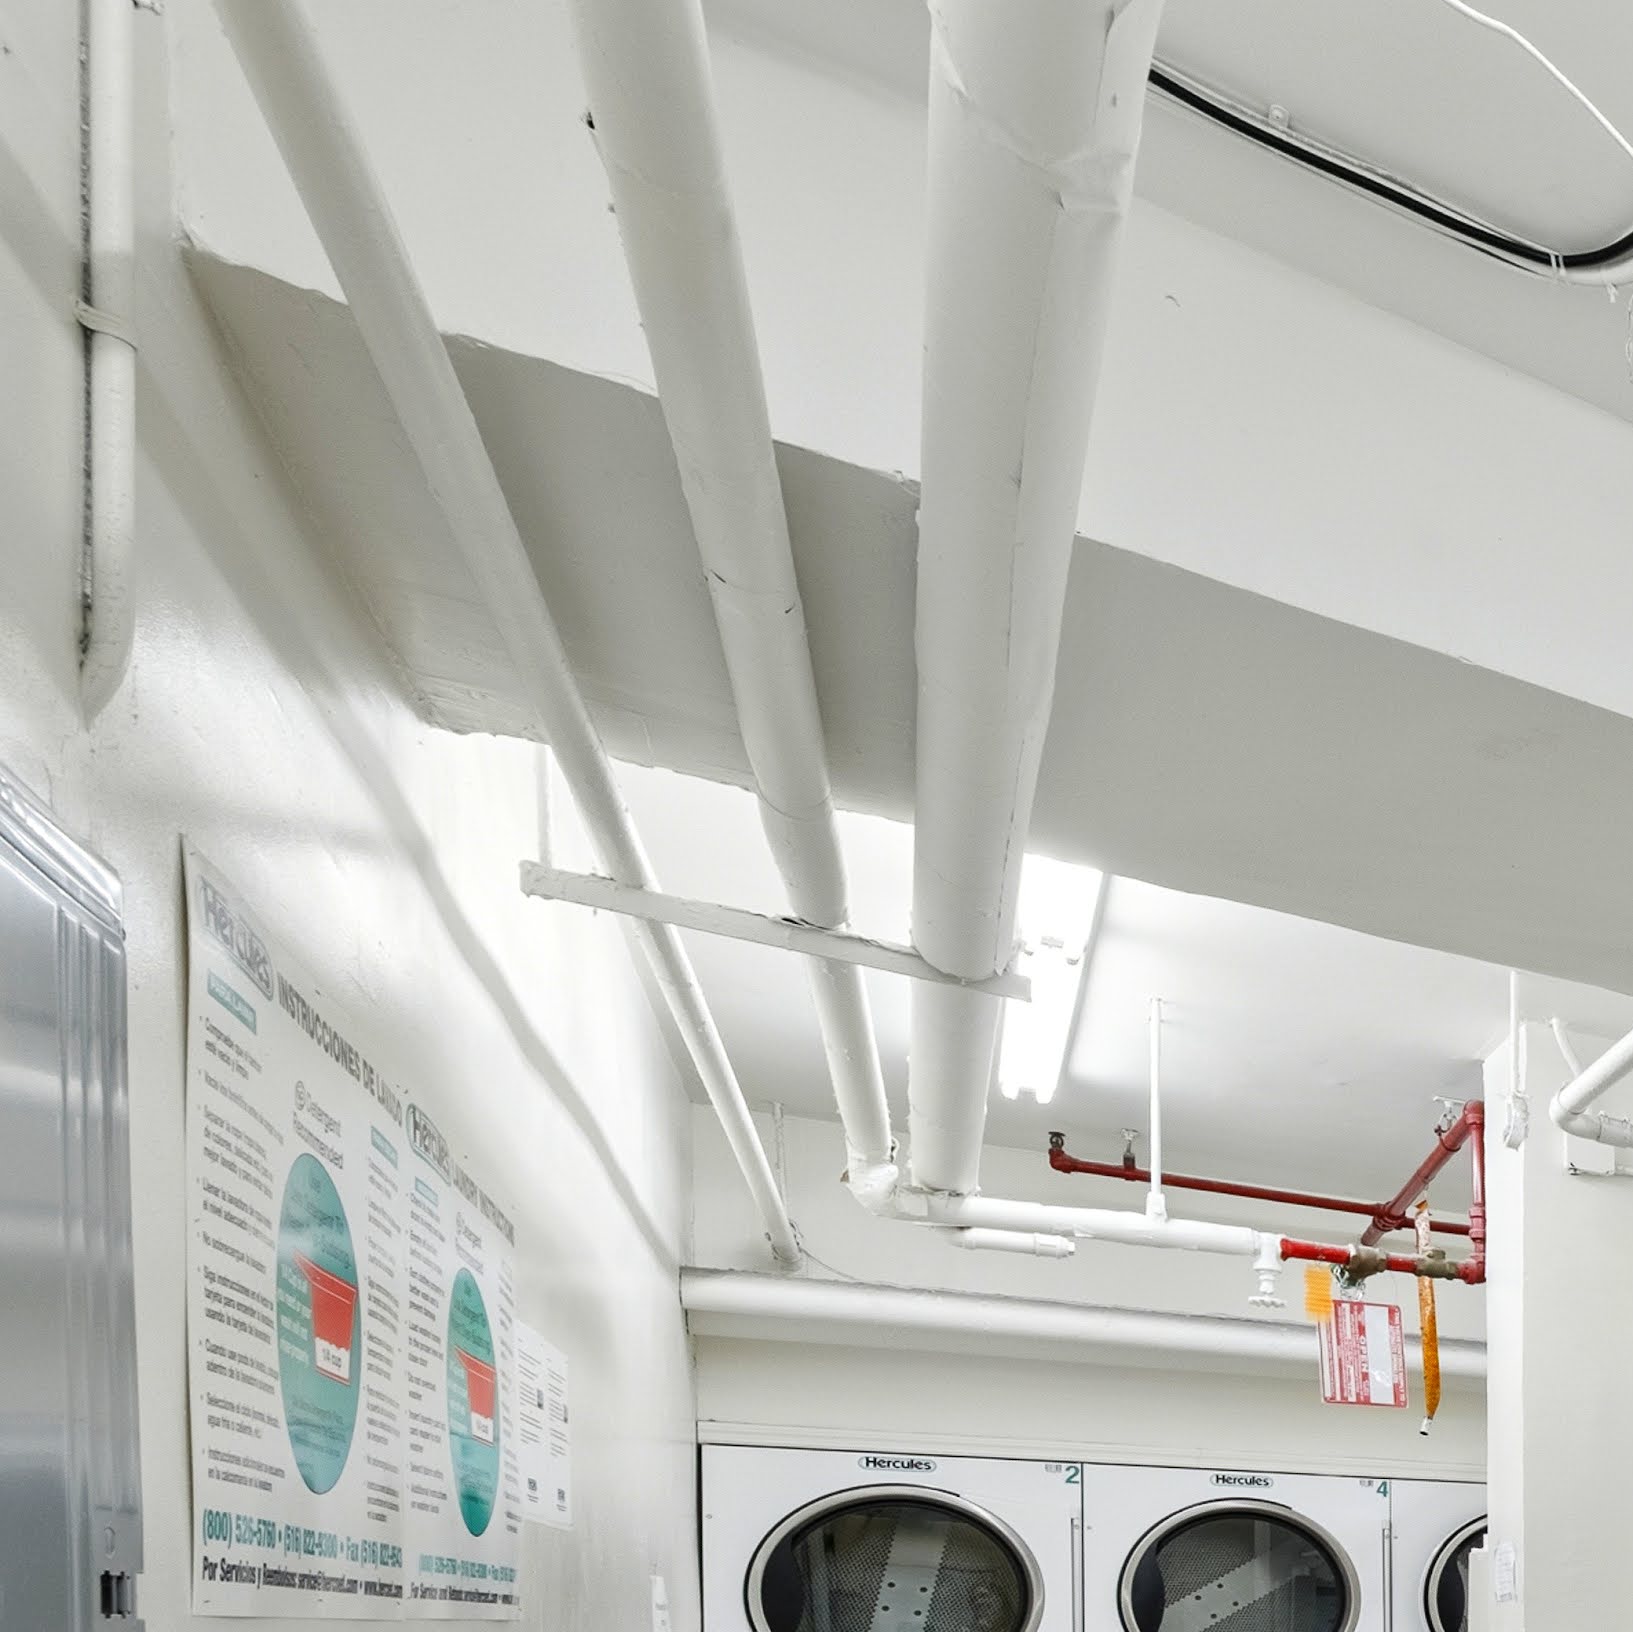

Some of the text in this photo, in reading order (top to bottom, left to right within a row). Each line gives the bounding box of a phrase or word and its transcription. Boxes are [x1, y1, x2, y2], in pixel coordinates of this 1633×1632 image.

[277, 971, 360, 1083] INSTRUCCIONES
[362, 1056, 375, 1098] DE
[865, 1456, 931, 1471] Hercules
[1065, 1465, 1080, 1485] 2
[1215, 1474, 1269, 1487] Hercules
[1376, 1480, 1389, 1498] 4
[203, 1508, 232, 1549] (800)
[203, 1556, 217, 1581] Por
[220, 1557, 256, 1584] Servicios
